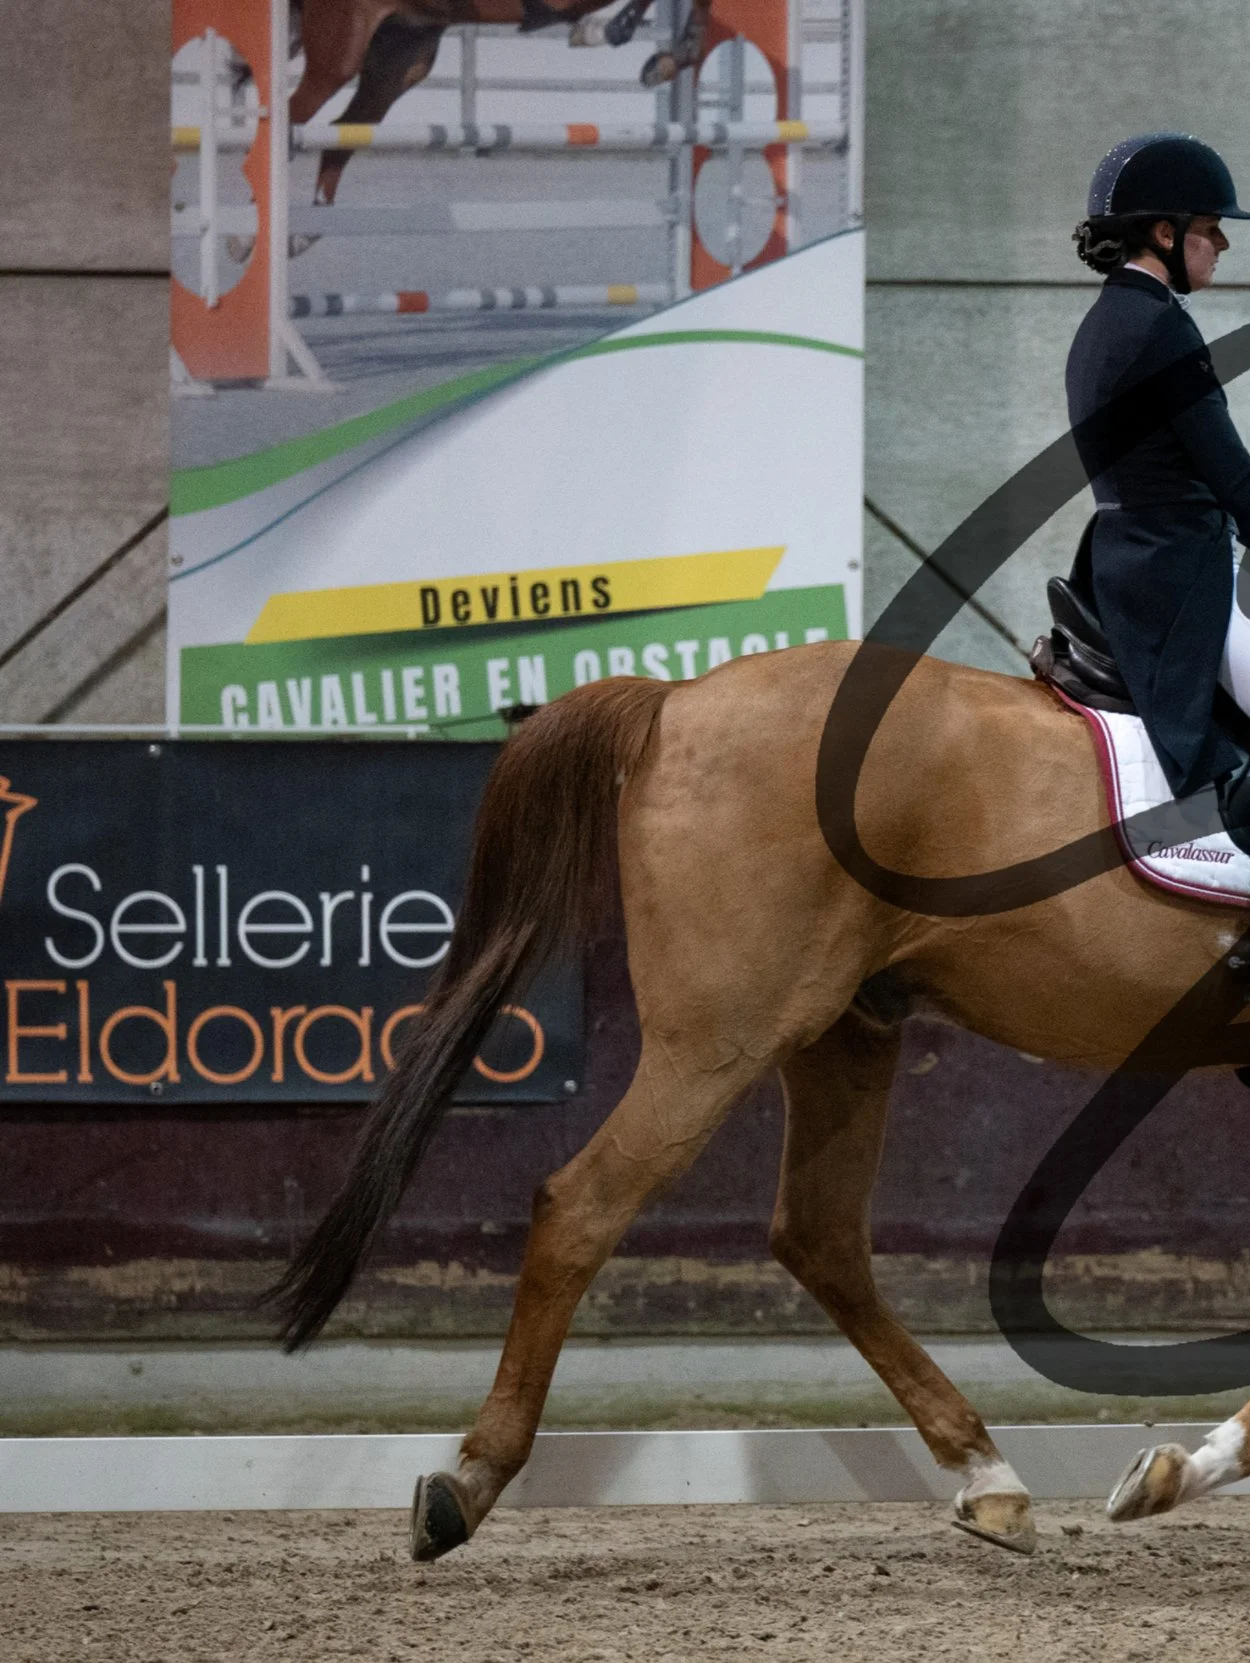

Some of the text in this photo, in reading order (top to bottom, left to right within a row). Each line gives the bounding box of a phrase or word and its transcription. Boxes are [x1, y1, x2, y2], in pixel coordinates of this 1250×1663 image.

[420, 575, 613, 626] Deviens
[220, 663, 462, 731] CAVALIER
[487, 654, 548, 711] EN
[1147, 840, 1235, 865] Cavalassur
[45, 863, 455, 969] Sellerie
